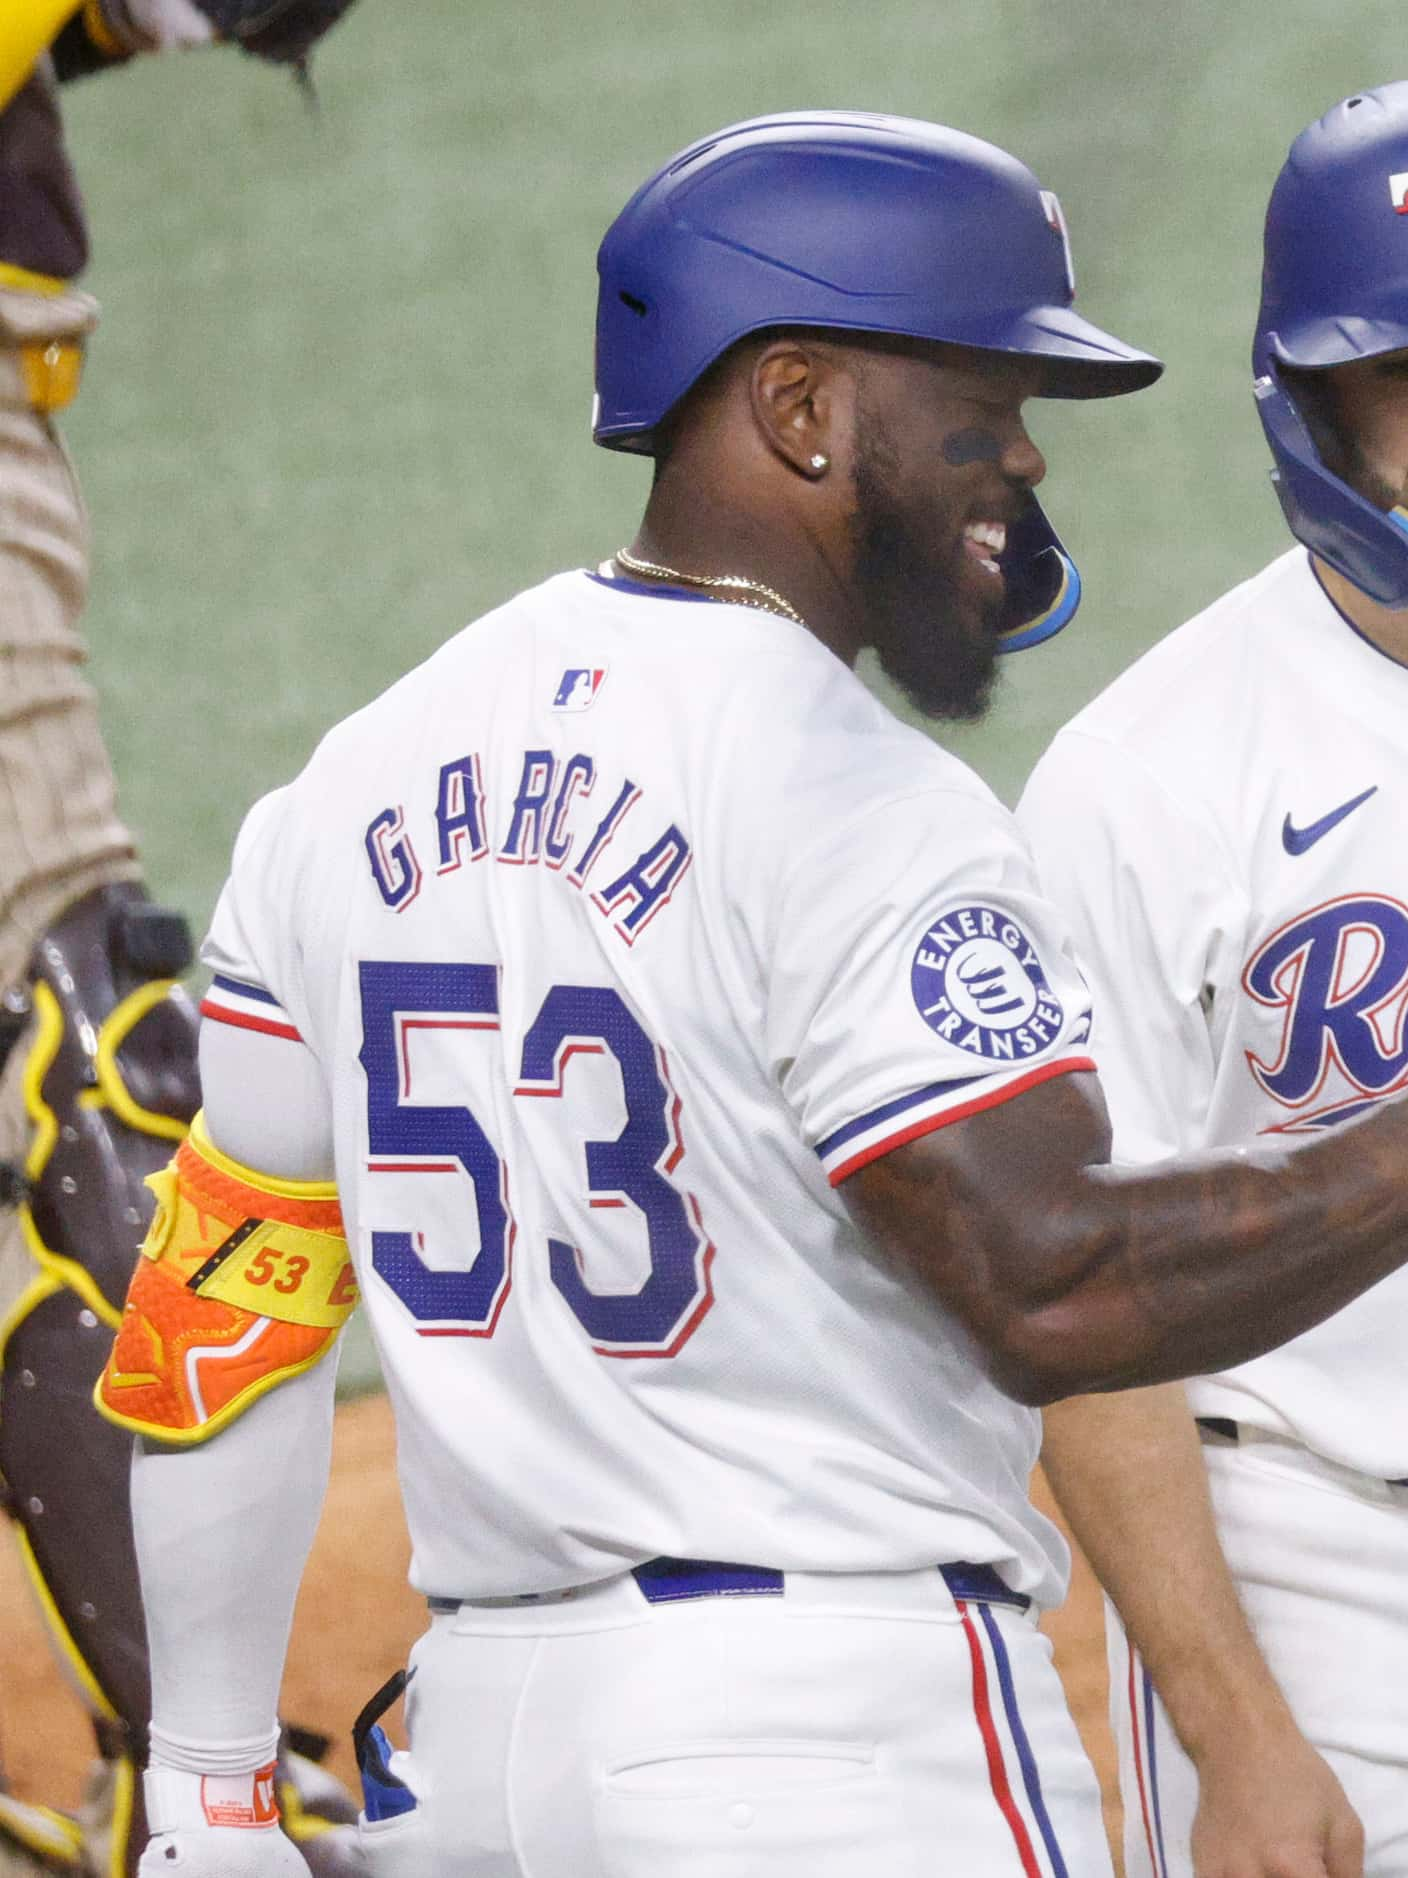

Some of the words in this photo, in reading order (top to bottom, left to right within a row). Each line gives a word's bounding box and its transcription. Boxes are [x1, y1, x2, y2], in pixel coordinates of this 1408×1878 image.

[916, 910, 1039, 971] ENERGY
[923, 988, 1063, 1060] TRANSFER
[357, 960, 718, 1359] 53
[244, 1246, 311, 1295] 53
